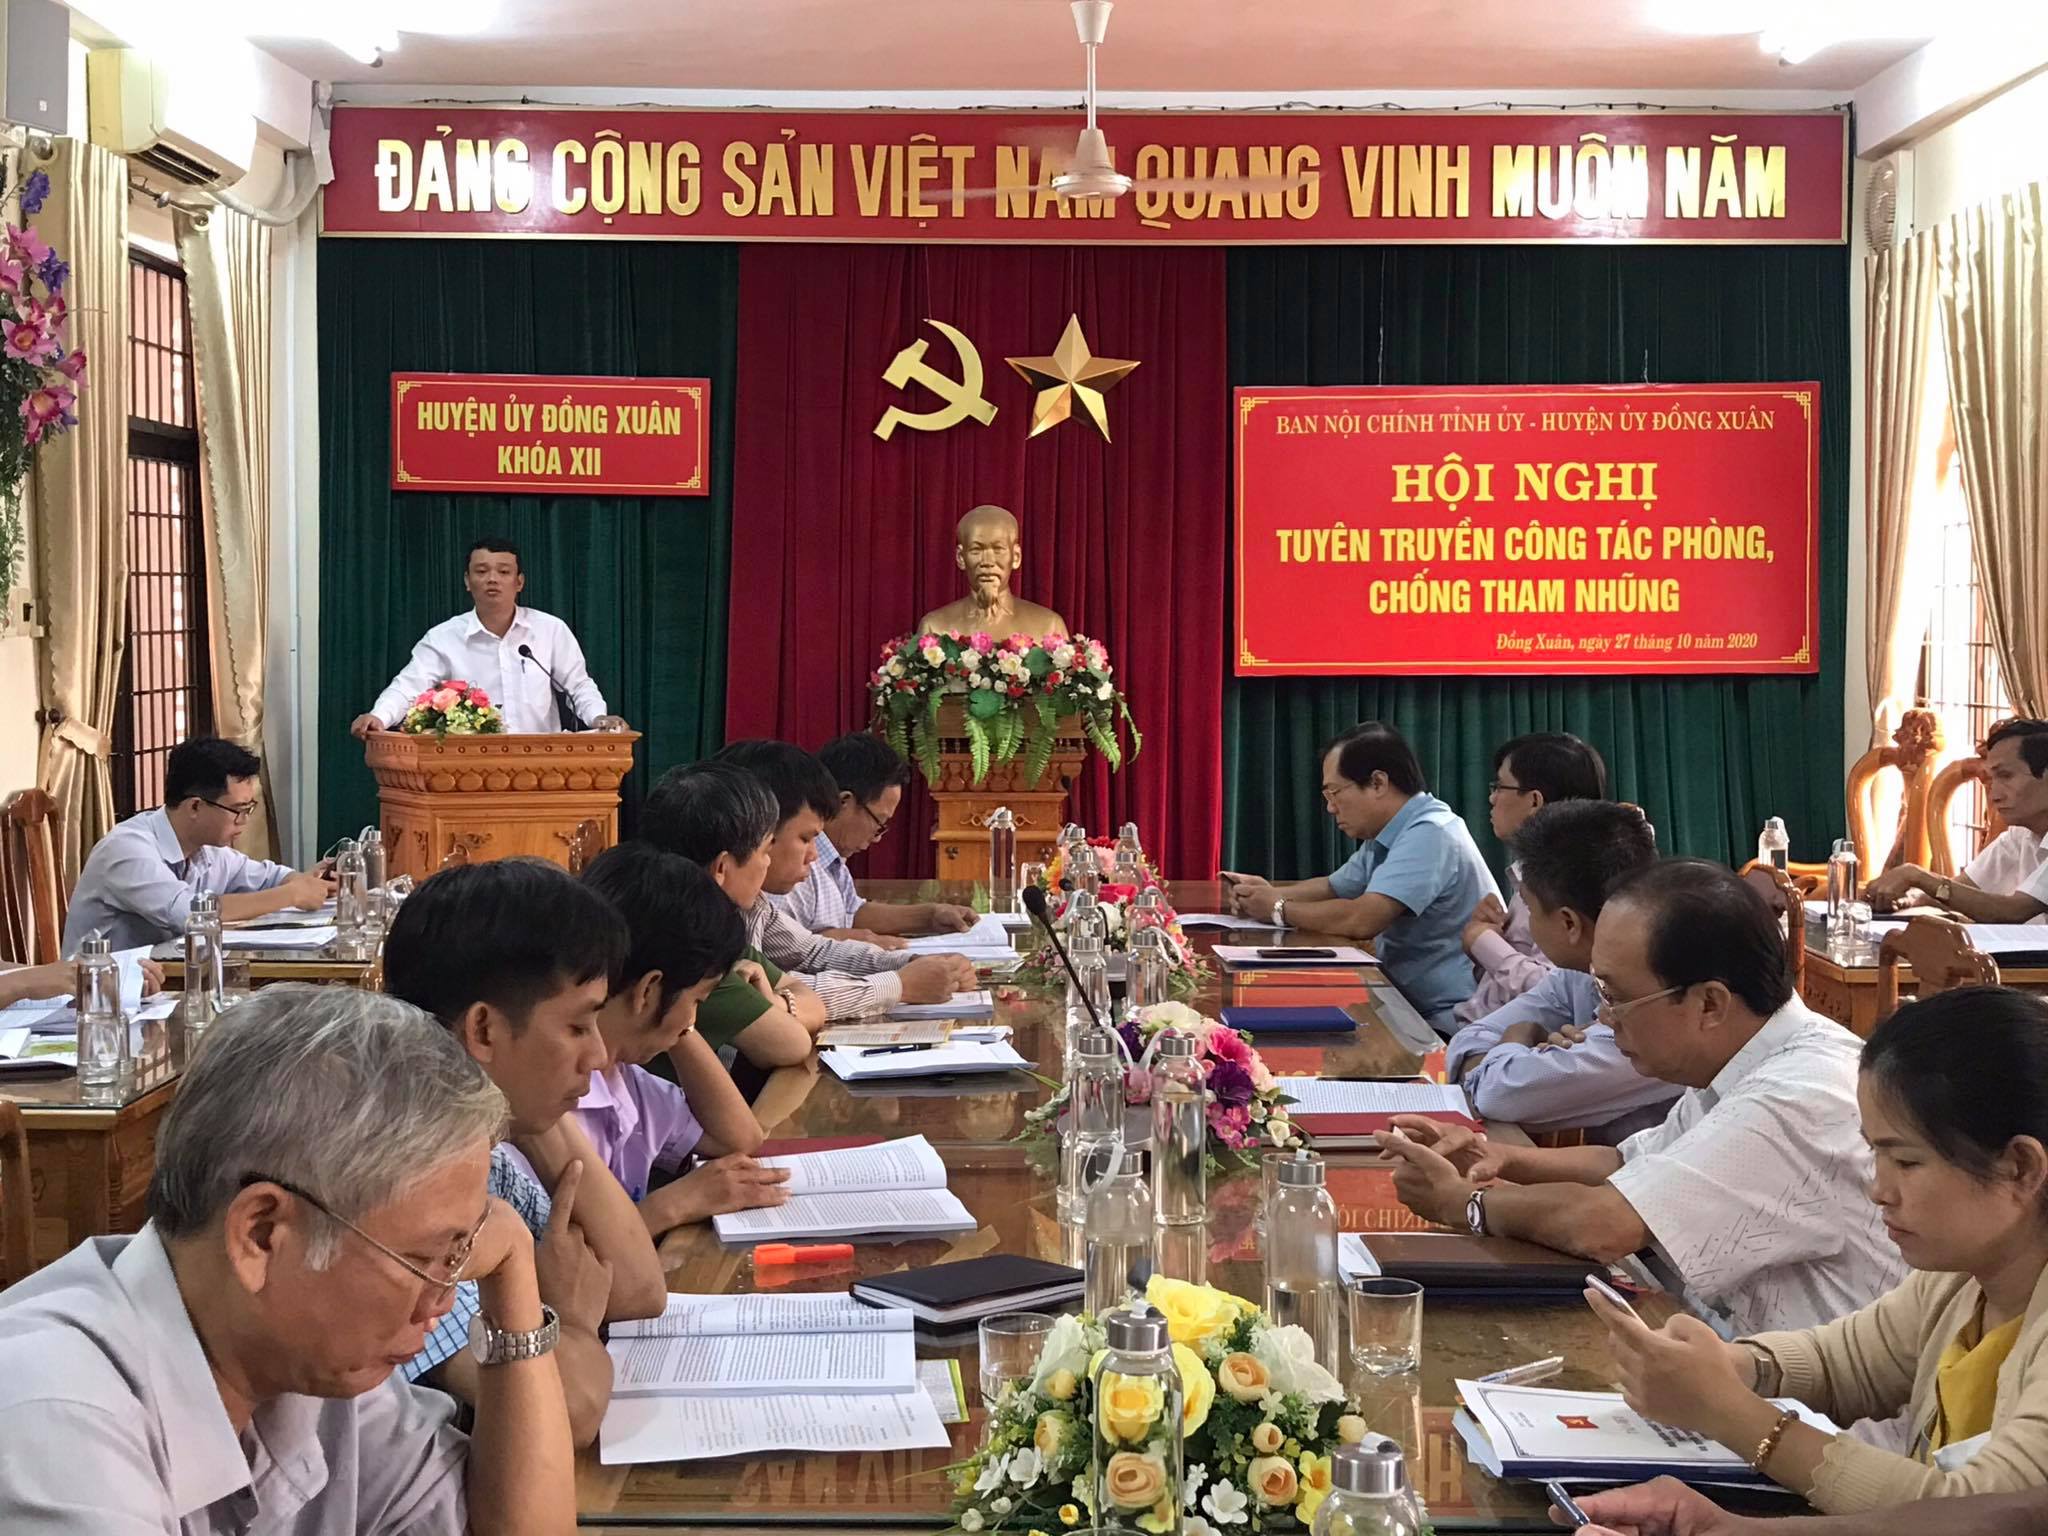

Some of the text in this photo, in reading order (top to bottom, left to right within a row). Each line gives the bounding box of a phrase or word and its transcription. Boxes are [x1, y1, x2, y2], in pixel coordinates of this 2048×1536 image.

[375, 125, 534, 213] ĐẢNG
[551, 129, 701, 225] CỘNG
[721, 129, 834, 217] SẢN
[850, 133, 975, 228] VIỆT
[1135, 143, 1319, 229] QUANG
[1342, 144, 1470, 218] VINH
[1492, 133, 1648, 219] MUÔN
[1665, 133, 1786, 218] NĂM
[417, 393, 681, 438] HUYỆN ỦY ĐỒNG XUÂN
[1276, 415, 1318, 435] BAN
[1324, 409, 1361, 440] NỘI
[1366, 408, 1435, 434] CHÍNH
[1439, 406, 1491, 433] TỈNH
[1496, 404, 1526, 433] ỦY
[1541, 406, 1614, 436] HUYỆN
[1619, 404, 1648, 432] ỦY
[1652, 402, 1712, 431] ĐỒNG
[1717, 404, 1775, 430] XUÂN
[497, 440, 601, 476] KHÓA XII
[1391, 452, 1658, 512] HỘI NGHỊ
[1276, 516, 1774, 564] TUYÊN TRUYỀN CÔNG TÁC PHÒNG,
[1369, 566, 1680, 615] CHỐNG THAM NHŨNG
[1496, 630, 1758, 653] Đồng Xuân, ngày 27 tháng 10 năm 2020
